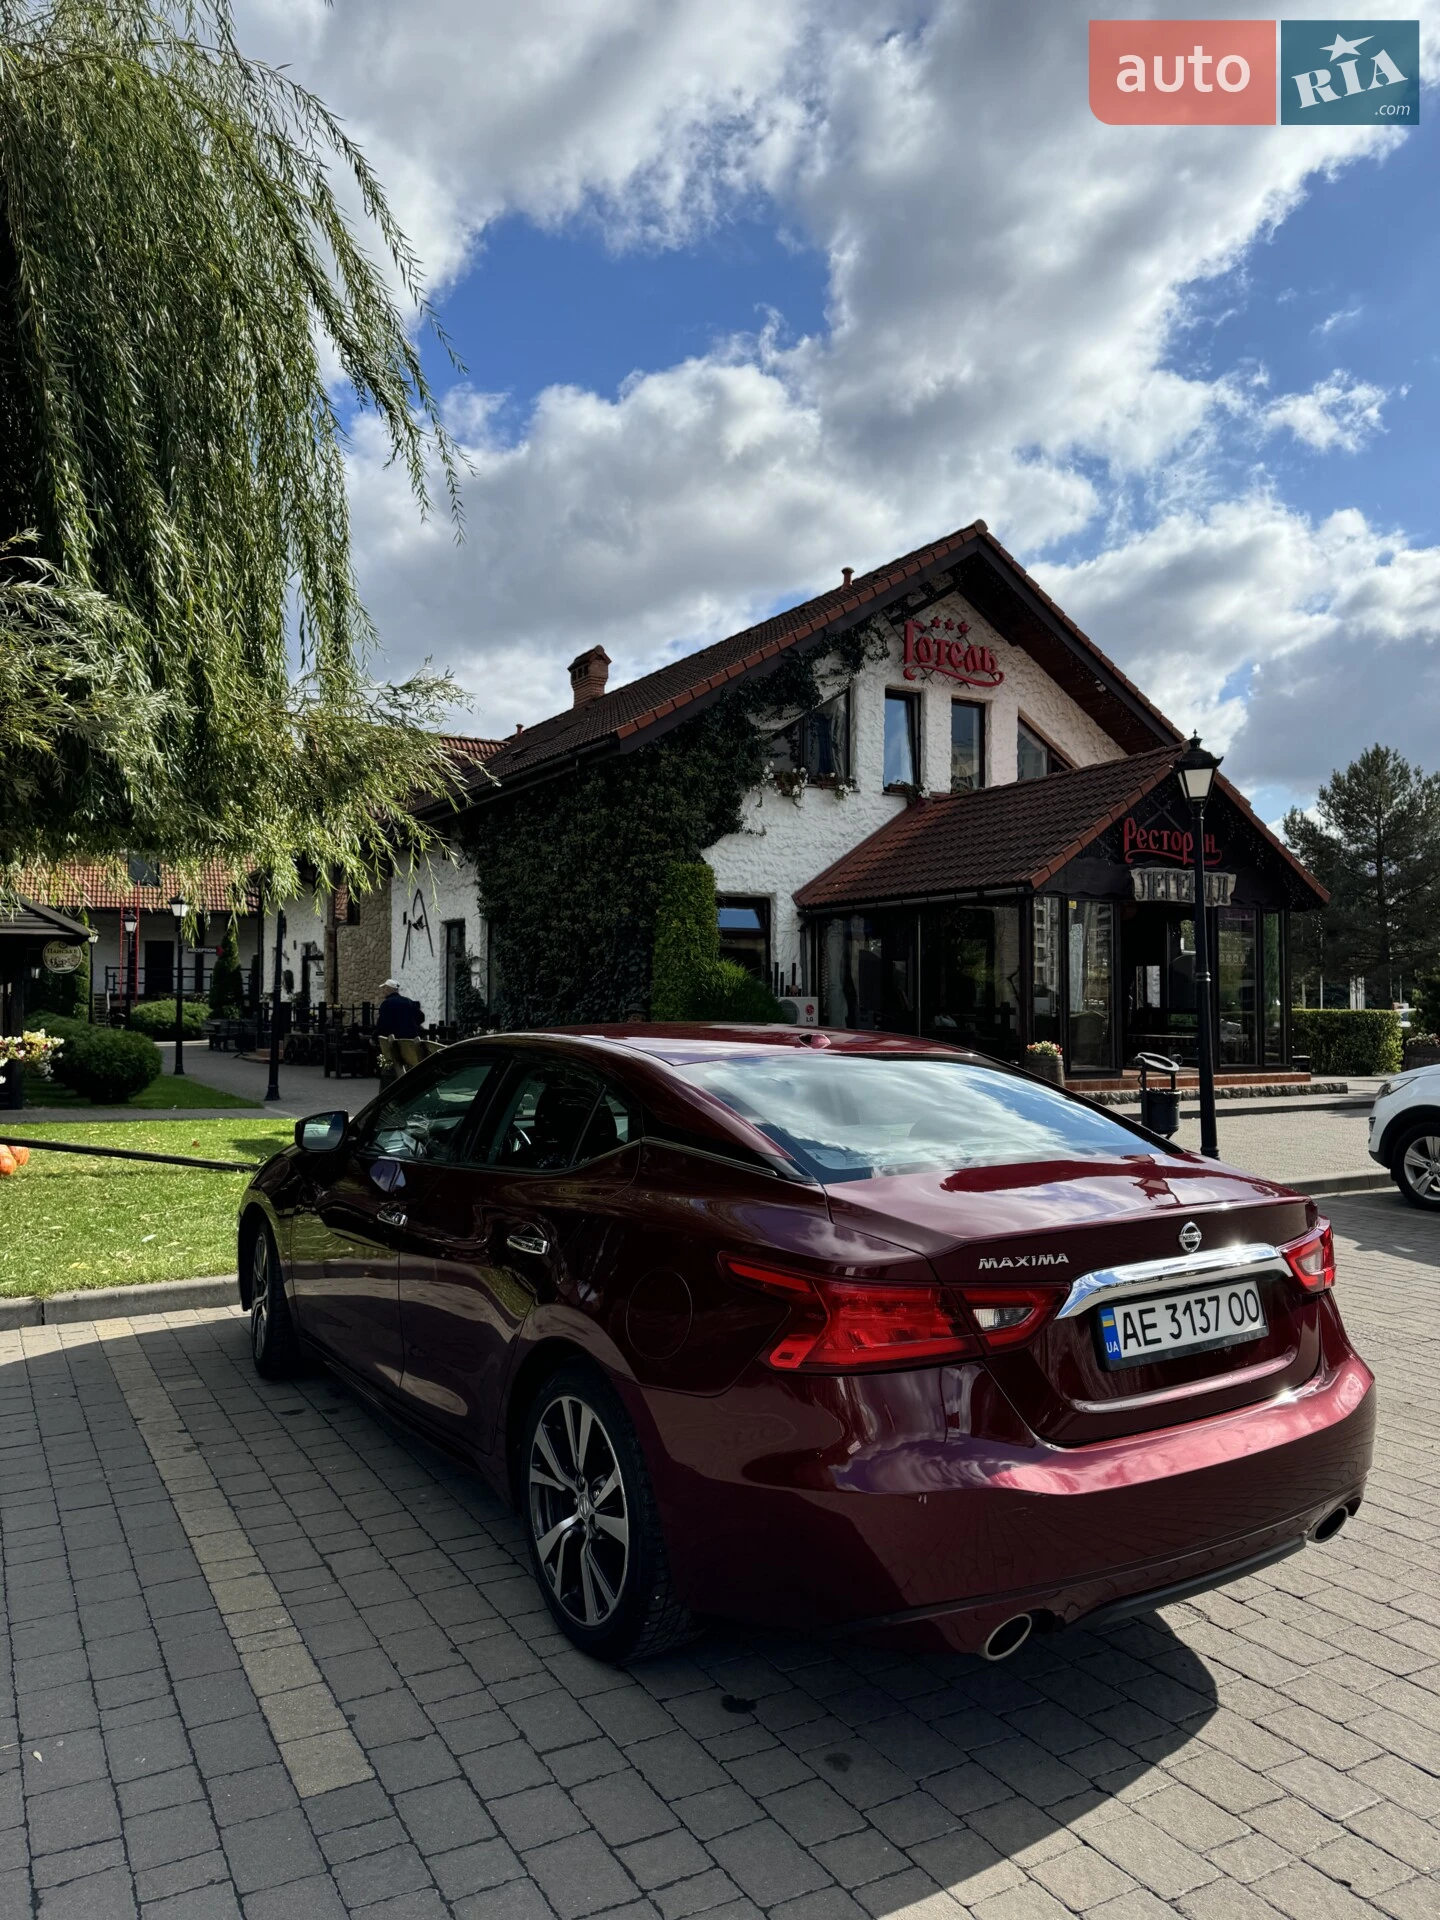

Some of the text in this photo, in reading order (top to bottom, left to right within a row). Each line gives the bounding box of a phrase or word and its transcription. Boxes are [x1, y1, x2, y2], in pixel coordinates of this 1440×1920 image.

[904, 619, 998, 674] Готель
[1124, 817, 1217, 865] Ресторн
[978, 1253, 1070, 1270] MAXIMA
[1106, 1340, 1120, 1353] UA
[1123, 1307, 1162, 1350] AE
[1165, 1295, 1220, 1340] 3137
